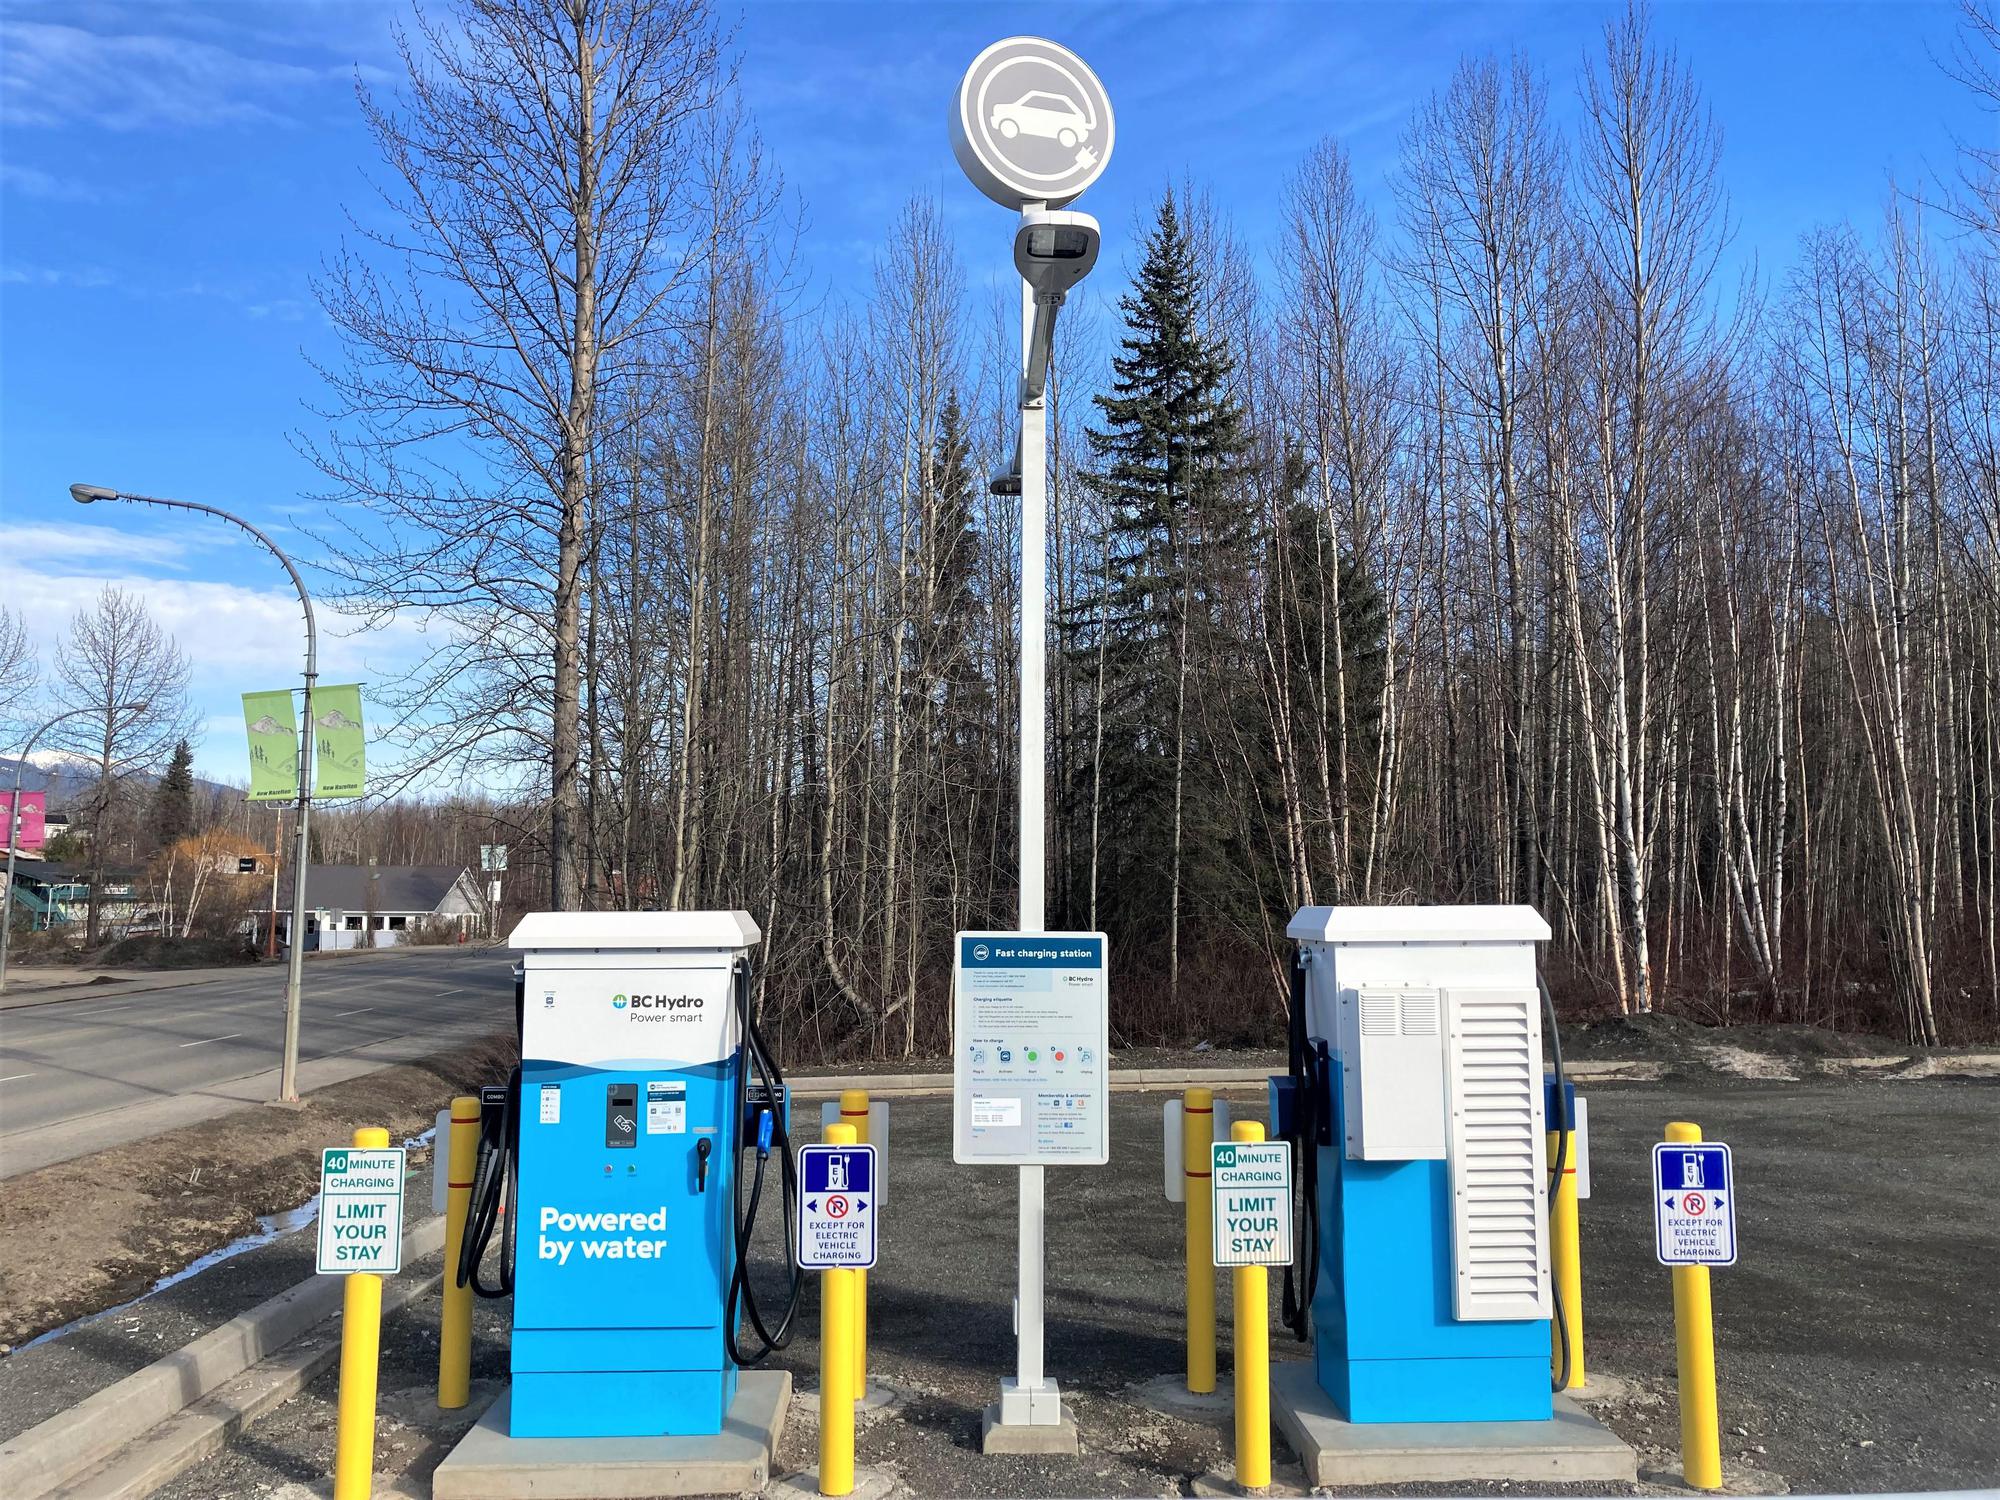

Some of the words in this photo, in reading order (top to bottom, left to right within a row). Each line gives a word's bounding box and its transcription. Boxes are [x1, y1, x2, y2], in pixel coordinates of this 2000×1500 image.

[996, 948, 1015, 958] Fast
[1017, 948, 1057, 960] charging
[1060, 949, 1092, 958] station
[631, 995, 653, 1008] BC
[655, 995, 704, 1010] Hydro
[630, 1013, 666, 1022] Power
[669, 1013, 703, 1022] smart
[327, 1157, 346, 1170] 40
[349, 1160, 395, 1169] MINUTE
[1216, 1151, 1235, 1164] 40
[1238, 1154, 1281, 1163] MINUTE
[330, 1178, 394, 1188] CHARGING
[1221, 1172, 1282, 1181] CHARGING
[336, 1204, 387, 1219] LIMIT
[1229, 1197, 1276, 1212] LIMIT
[540, 1206, 667, 1232] Powered
[847, 1221, 865, 1229] FOR
[1227, 1217, 1278, 1232] YOUR
[1668, 1219, 1702, 1227] EXCEPT
[1705, 1218, 1723, 1226] FOR
[333, 1224, 387, 1239] YOUR
[336, 1245, 383, 1260] STAY
[539, 1235, 574, 1265] by
[581, 1238, 667, 1259] water
[1231, 1238, 1275, 1253] STAY
[1673, 1248, 1721, 1256] CHARGING
